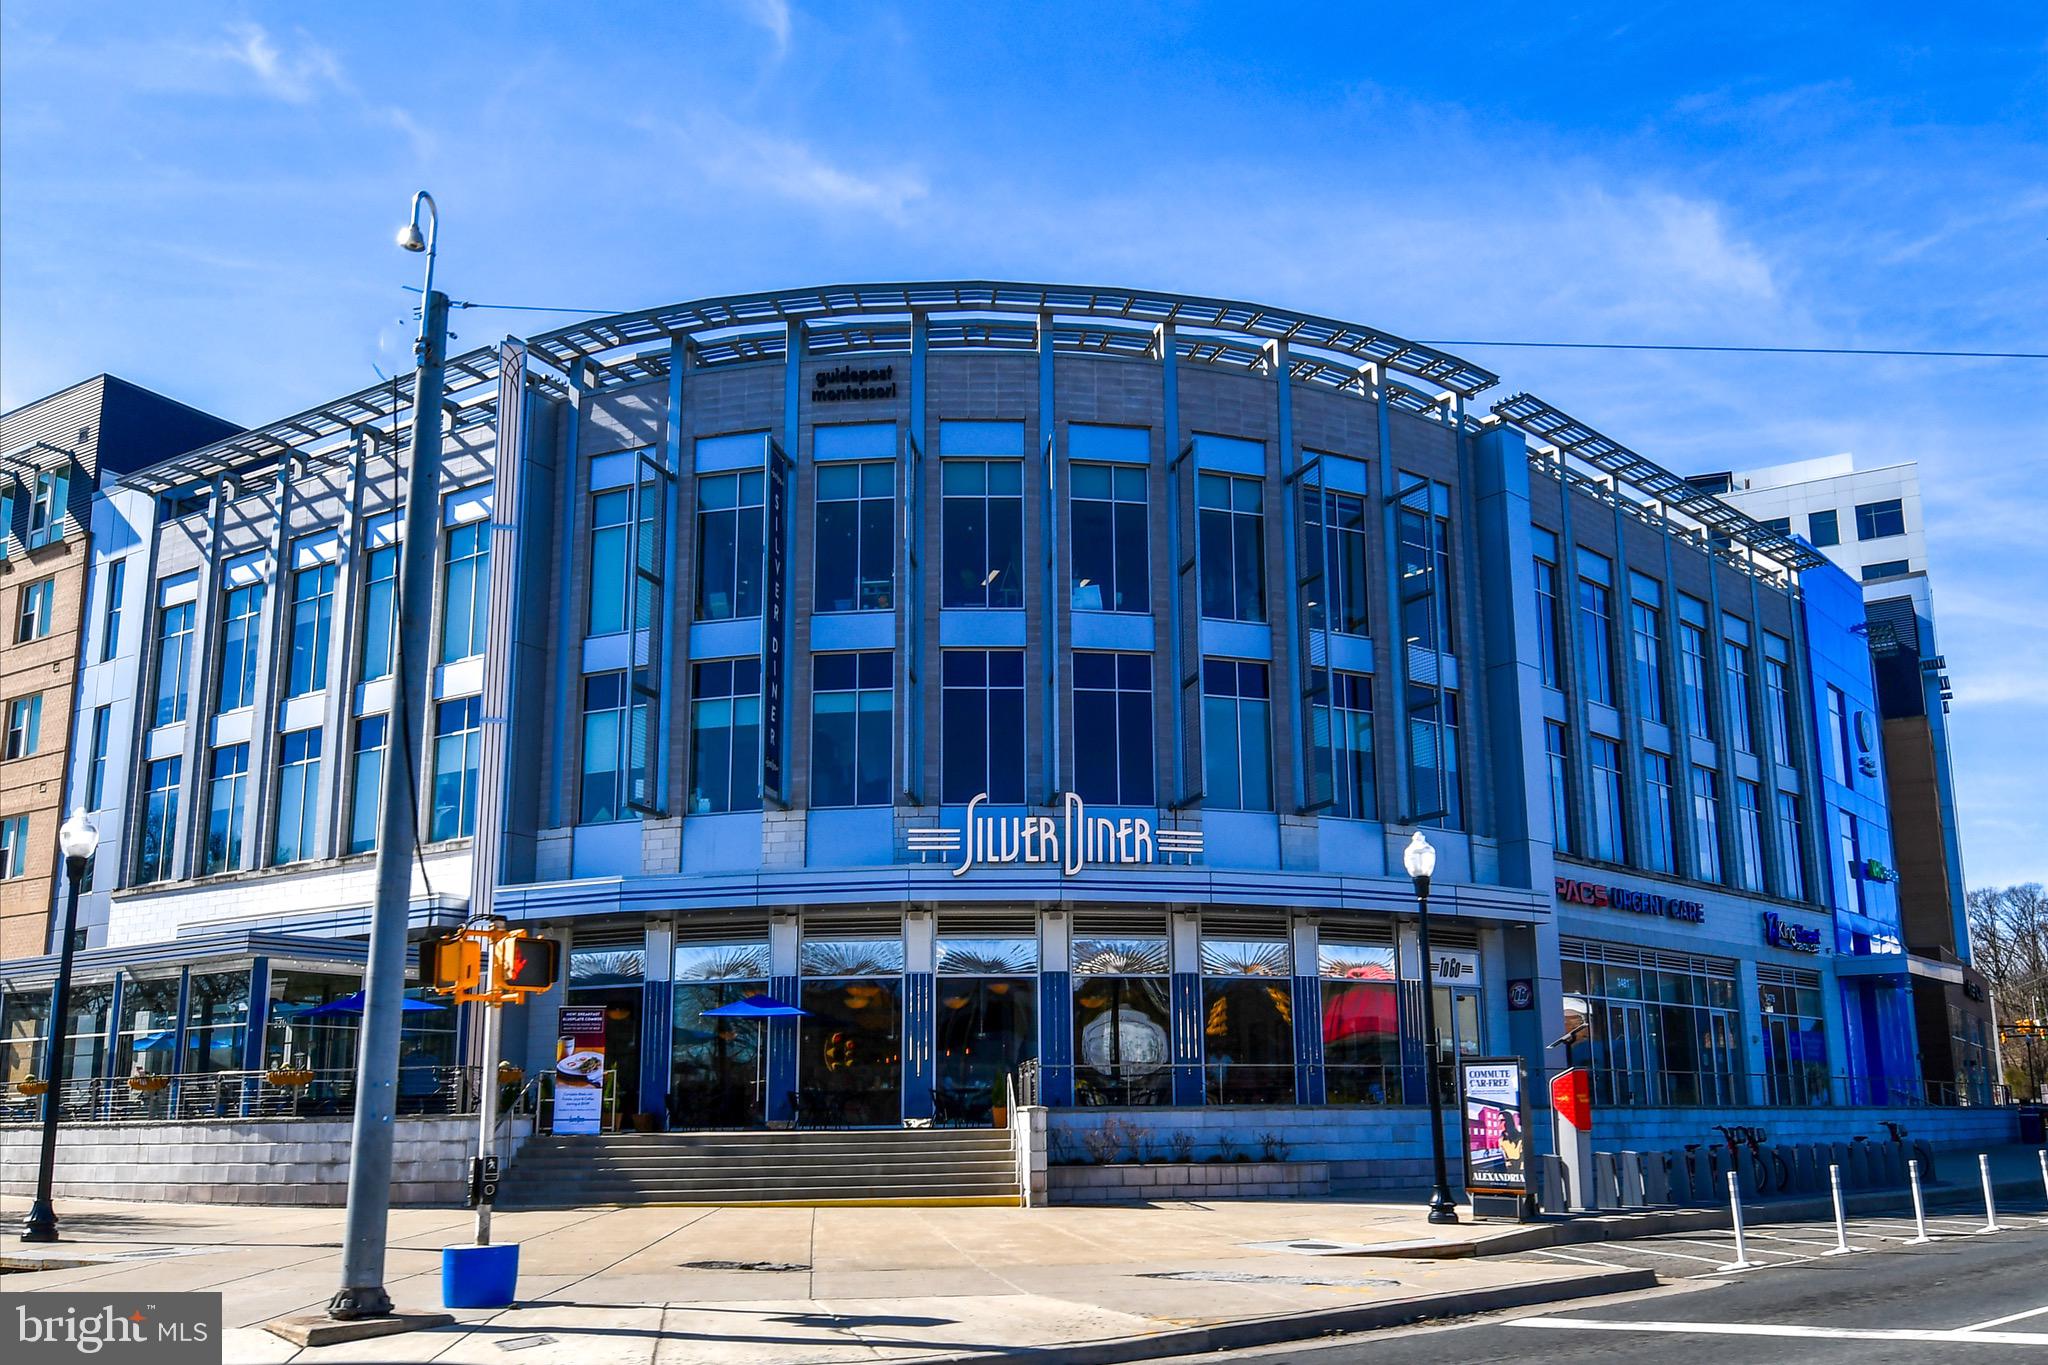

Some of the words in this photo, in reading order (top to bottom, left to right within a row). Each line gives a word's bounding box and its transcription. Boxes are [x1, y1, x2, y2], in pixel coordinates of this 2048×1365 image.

[815, 365, 893, 388] guidepost
[812, 382, 896, 402] montessori
[773, 494, 781, 622] SILVER
[769, 636, 779, 746] DINER
[952, 792, 1059, 877] SILVER
[1064, 792, 1153, 876] DINER
[1555, 876, 1608, 907] PACS
[1611, 887, 1666, 917] URGENT
[1669, 898, 1705, 923] CARE
[1469, 1070, 1511, 1079] COMMUTE
[1469, 1079, 1509, 1088] CAR-FREE
[1472, 1172, 1526, 1183] ALEXANDRIA
